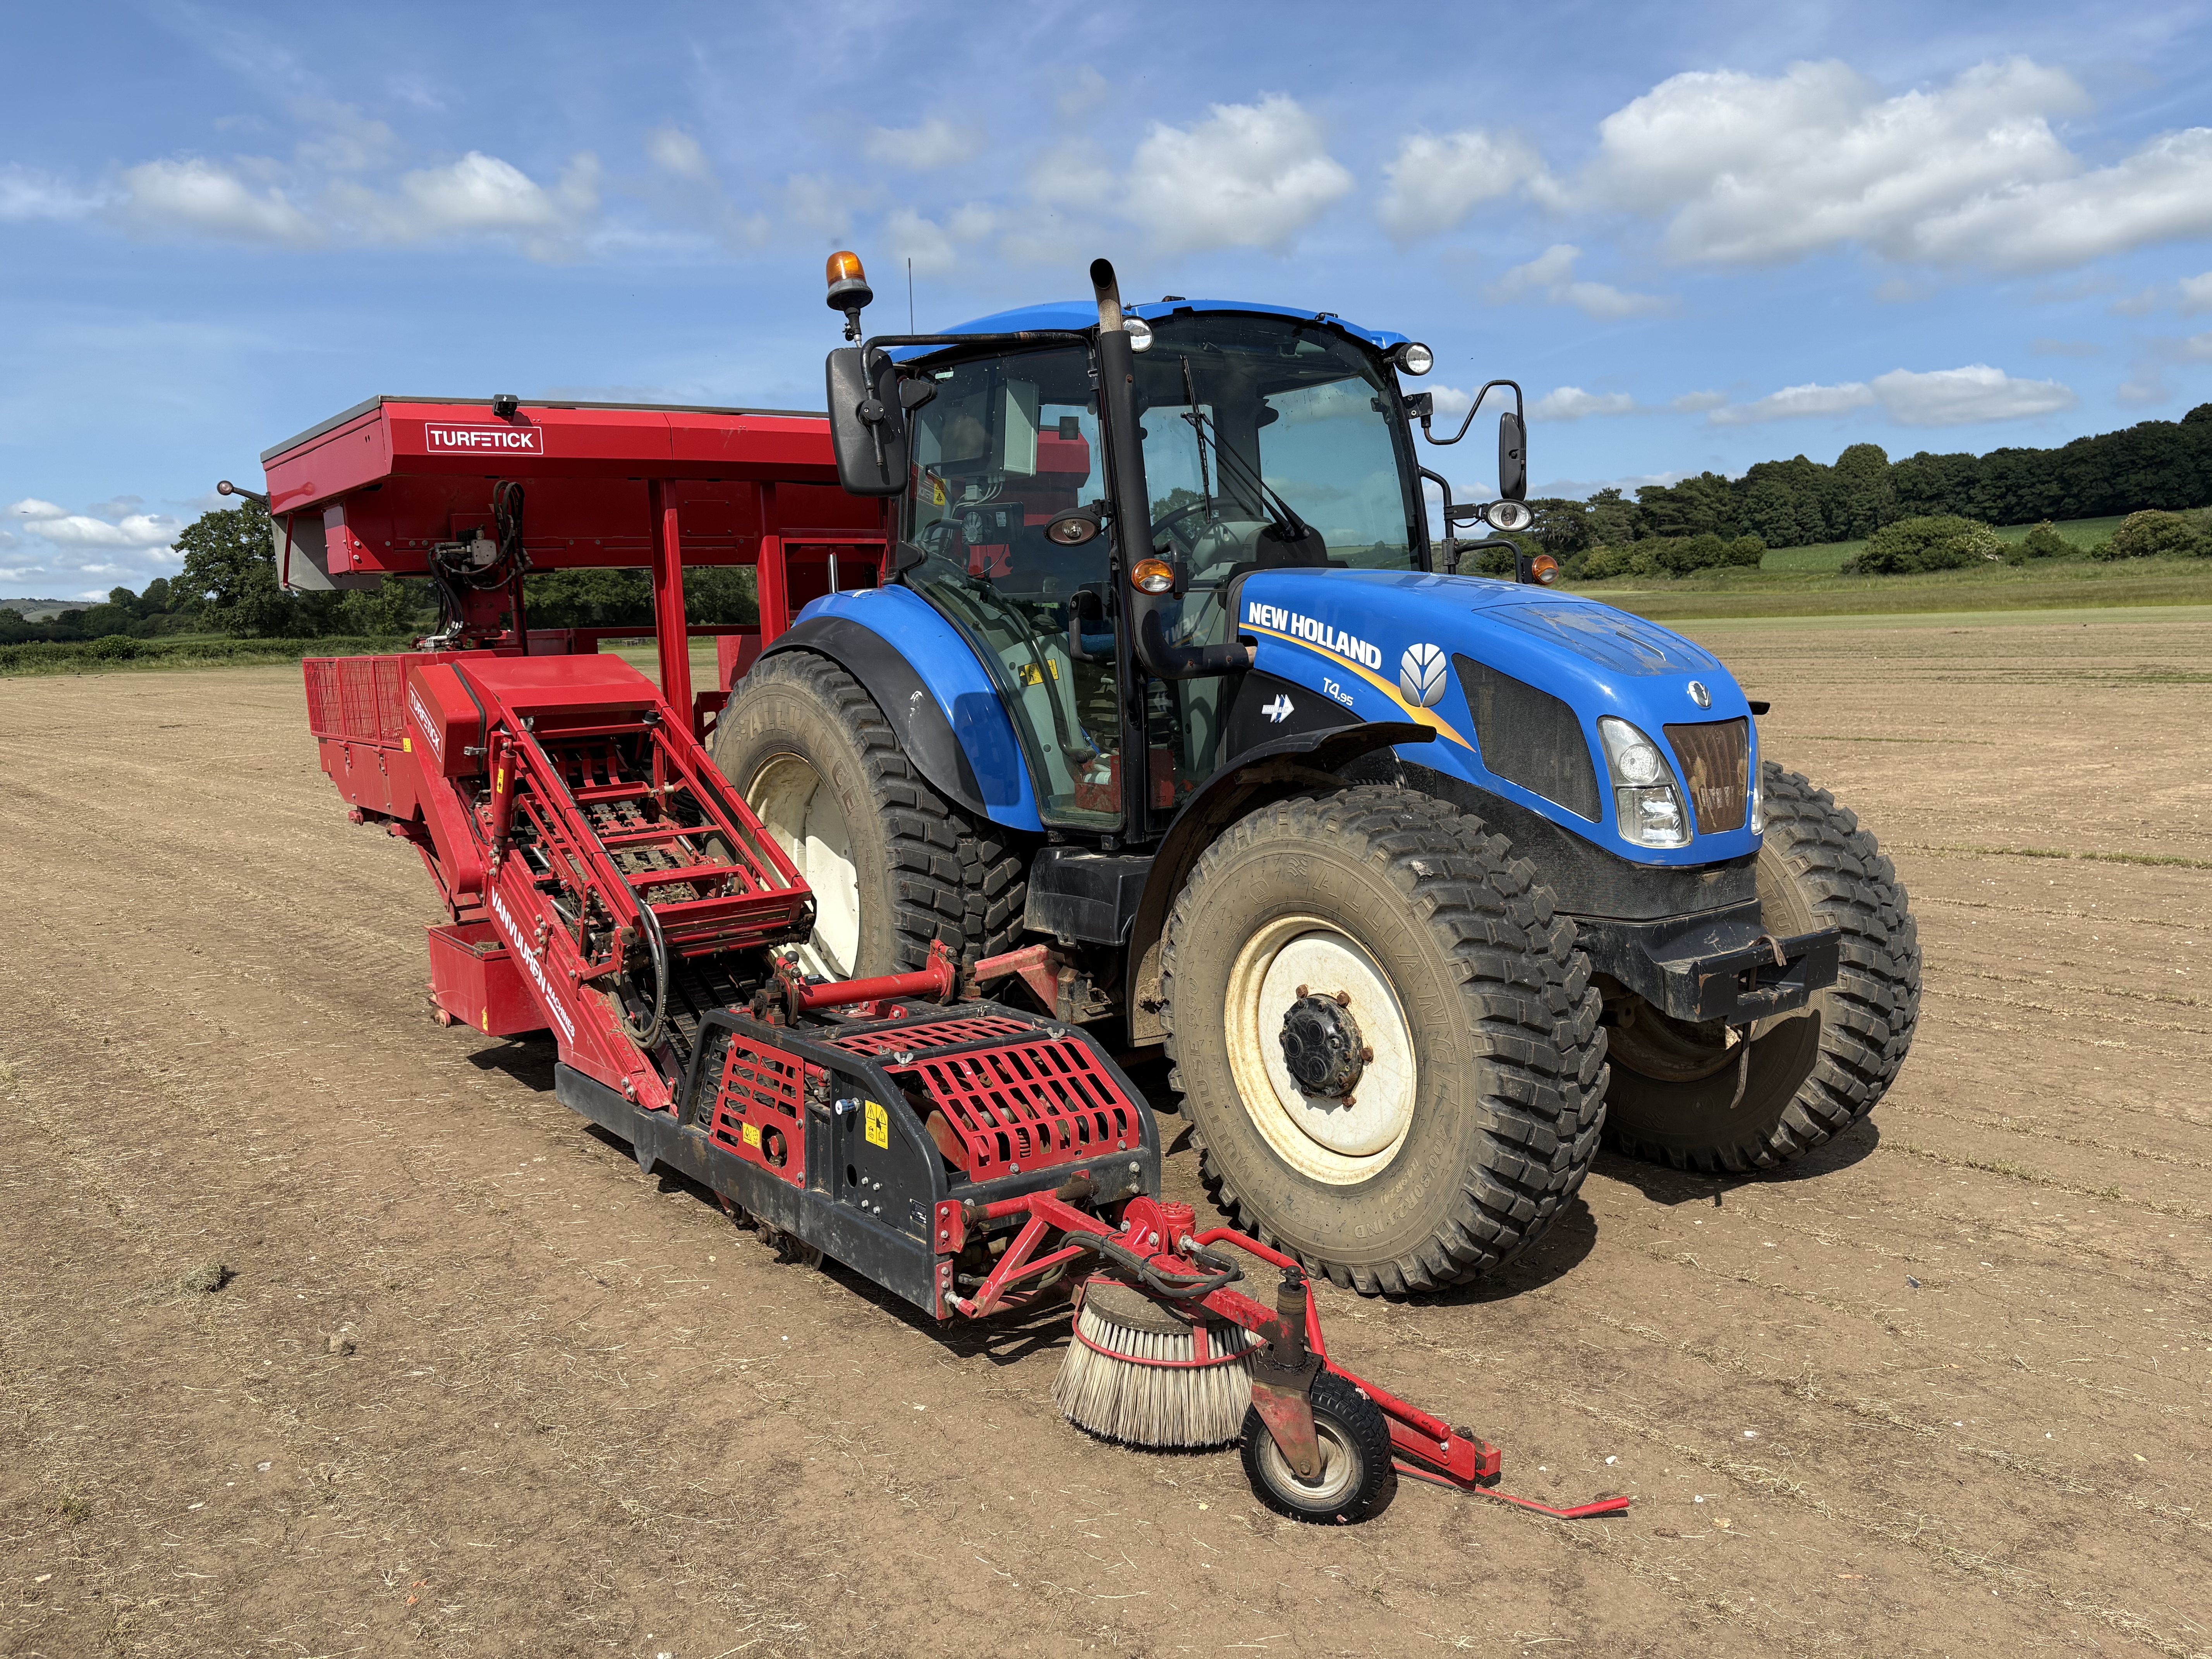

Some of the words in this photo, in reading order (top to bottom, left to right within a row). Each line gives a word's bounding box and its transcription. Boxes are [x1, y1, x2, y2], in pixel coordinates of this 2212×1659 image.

[430, 430, 534, 448] TURFETICK
[1249, 602, 1288, 631] NEW
[1291, 613, 1382, 670] HOLLAND
[410, 689, 440, 751] TURFETICK
[1323, 677, 1353, 706] T4.95
[750, 700, 861, 815] ALLIANCE
[1755, 871, 1791, 931] LTIU
[547, 982, 575, 1037] MACHINES
[1186, 977, 1199, 1029] 550
[1313, 863, 1458, 1105] ALLIANCE
[1189, 1039, 1254, 1183] MULTIUSE
[1245, 1143, 1260, 1164] STEEL
[1387, 1124, 1448, 1226] 400/80R24
[1354, 1218, 1385, 1238] IND
